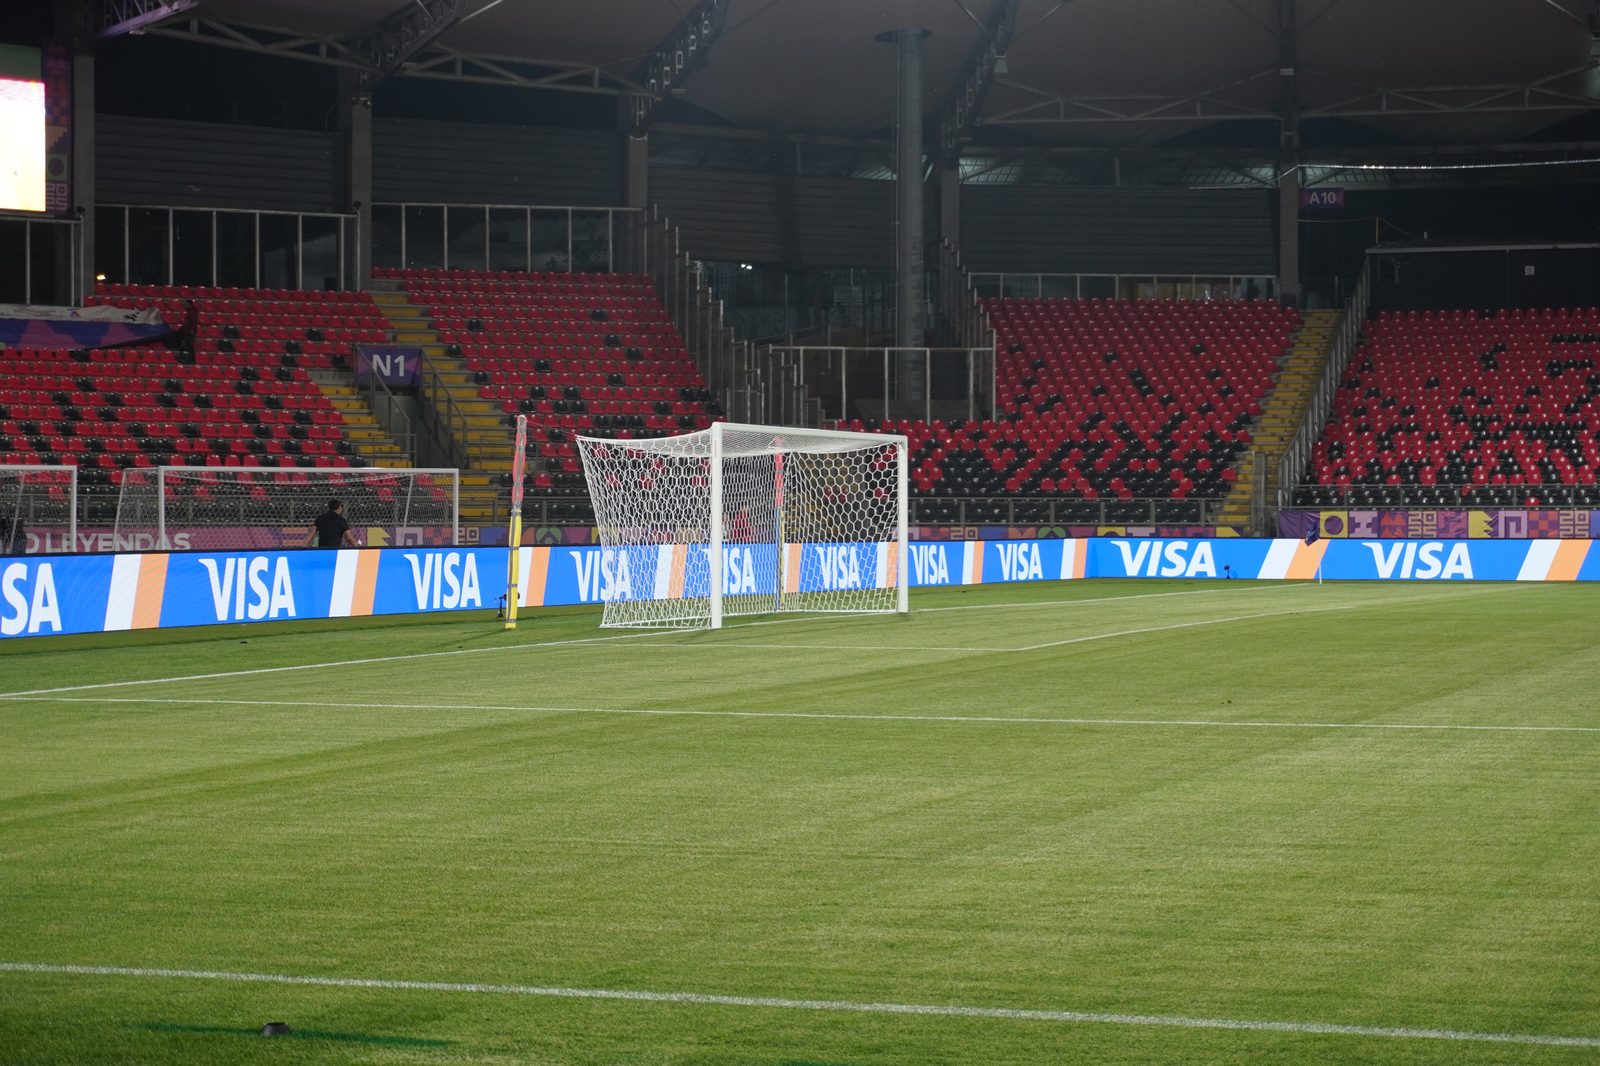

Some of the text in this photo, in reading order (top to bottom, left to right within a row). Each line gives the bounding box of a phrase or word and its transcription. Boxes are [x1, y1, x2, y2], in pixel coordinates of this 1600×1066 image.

[1310, 191, 1336, 204] A10
[372, 354, 405, 377] N1
[45, 532, 191, 553] LEYENDAS
[995, 543, 1043, 580] VISA
[1110, 541, 1216, 577] VISA
[1361, 542, 1473, 579] VISA
[403, 552, 482, 609] VISA
[569, 550, 632, 602] VISA
[815, 546, 861, 588] VISA
[909, 544, 949, 584] VISA
[0, 562, 63, 635] SA
[198, 556, 296, 621] VISA
